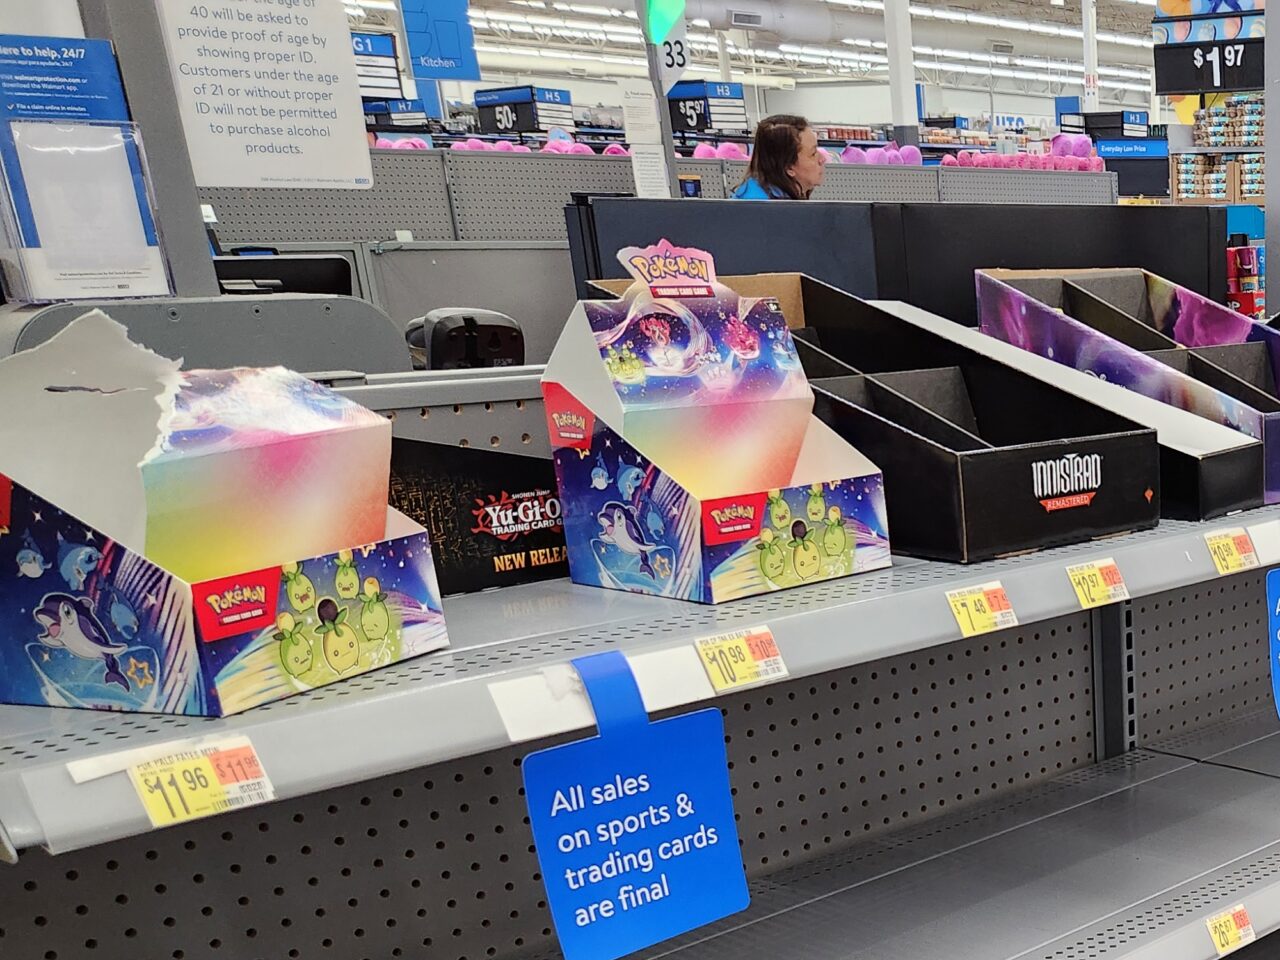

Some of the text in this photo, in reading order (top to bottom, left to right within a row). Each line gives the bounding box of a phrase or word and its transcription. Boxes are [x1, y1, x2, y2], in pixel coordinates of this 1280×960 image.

[190, 5, 308, 26] 40 will be asked to
[178, 26, 327, 48] provide proof of age by
[20, 46, 33, 57] to
[33, 46, 61, 60] help,
[61, 47, 85, 59] 24/7
[197, 45, 317, 64] showing proper ID.
[420, 56, 456, 68] Kitchen
[662, 39, 686, 69] 33
[179, 62, 339, 85] Customers under the age
[193, 83, 333, 103] of 21 or without proper
[195, 102, 338, 120] ID will not be permitted
[209, 123, 331, 137] to purchase alcohol
[246, 143, 304, 155] products.
[1101, 144, 1124, 154] Everyday
[1134, 144, 1147, 153] Price
[1031, 452, 1102, 499] INNISTRAD
[511, 489, 551, 500] SHONEN JUMP
[1047, 495, 1090, 509] REMASTERED
[484, 498, 561, 528] Yu-Gi-O
[492, 523, 530, 536] TRADING
[531, 519, 555, 530] CARD
[493, 545, 568, 573] NEW RELEA
[551, 773, 650, 817] All sales
[558, 793, 695, 854] on sports &
[565, 824, 719, 890] trading cards
[575, 874, 670, 927] are final
